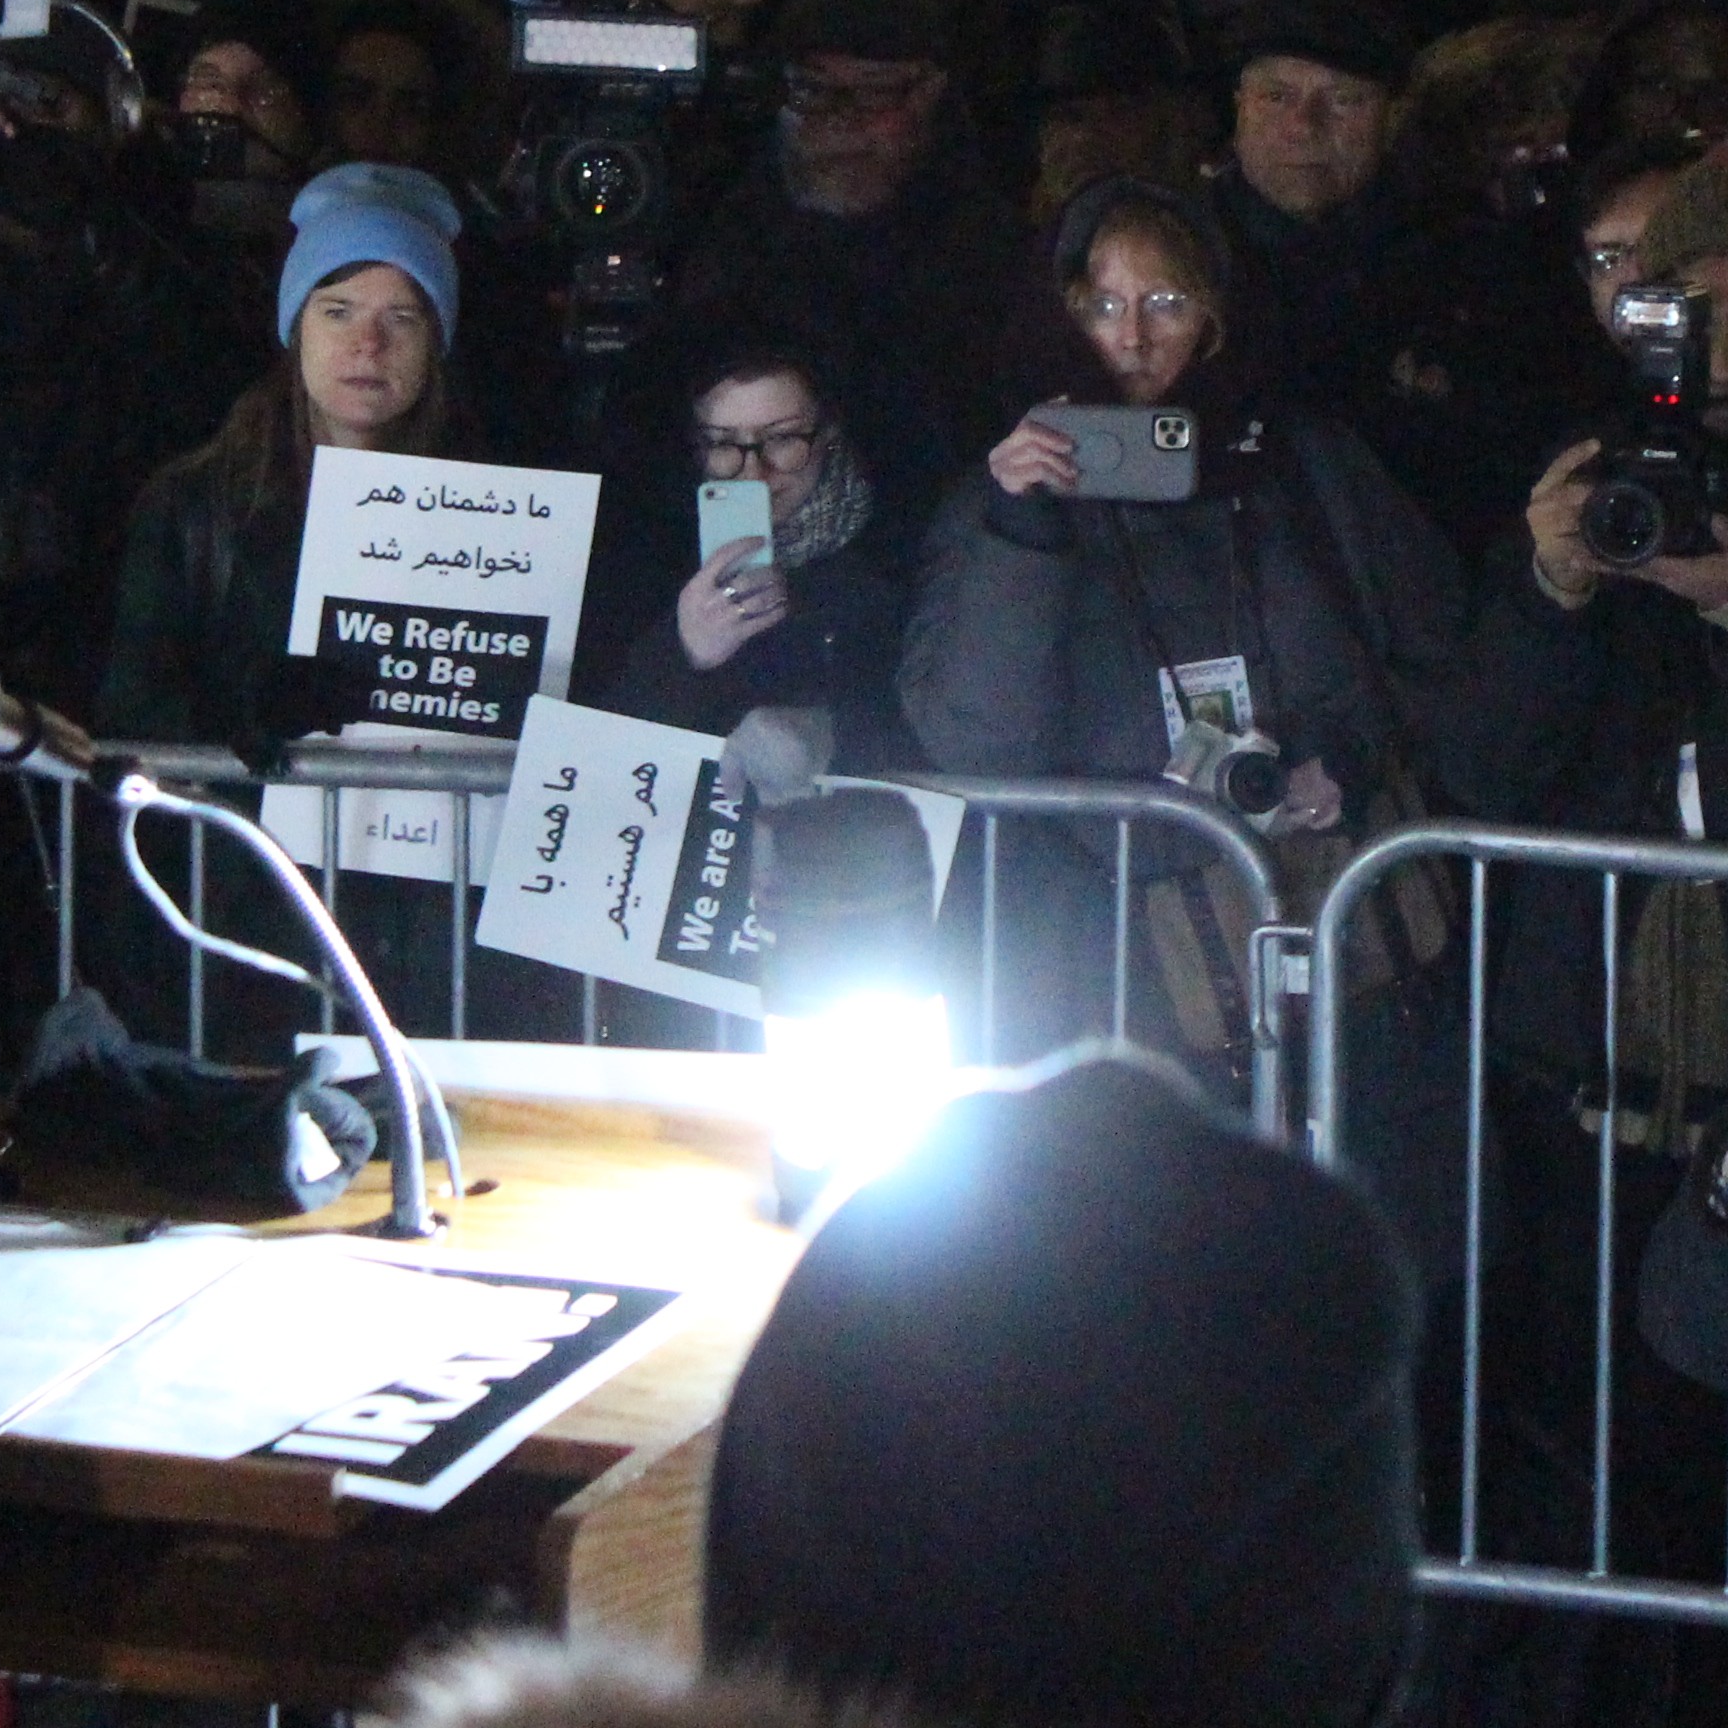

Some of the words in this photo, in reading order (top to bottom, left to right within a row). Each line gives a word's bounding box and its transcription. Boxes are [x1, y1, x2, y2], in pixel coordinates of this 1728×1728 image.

[356, 483, 407, 508] هم
[416, 483, 517, 516] دشمنان
[528, 493, 552, 520] ما
[359, 537, 404, 562] شد
[335, 608, 394, 647] We
[403, 617, 532, 659] Refuse
[377, 653, 419, 681] to
[426, 656, 478, 689] Be
[369, 690, 502, 725] nemies
[542, 766, 578, 792] ما
[631, 761, 659, 817] هم
[535, 802, 570, 863] همه
[520, 874, 567, 895] با
[675, 894, 721, 953] We
[699, 826, 737, 889] are
